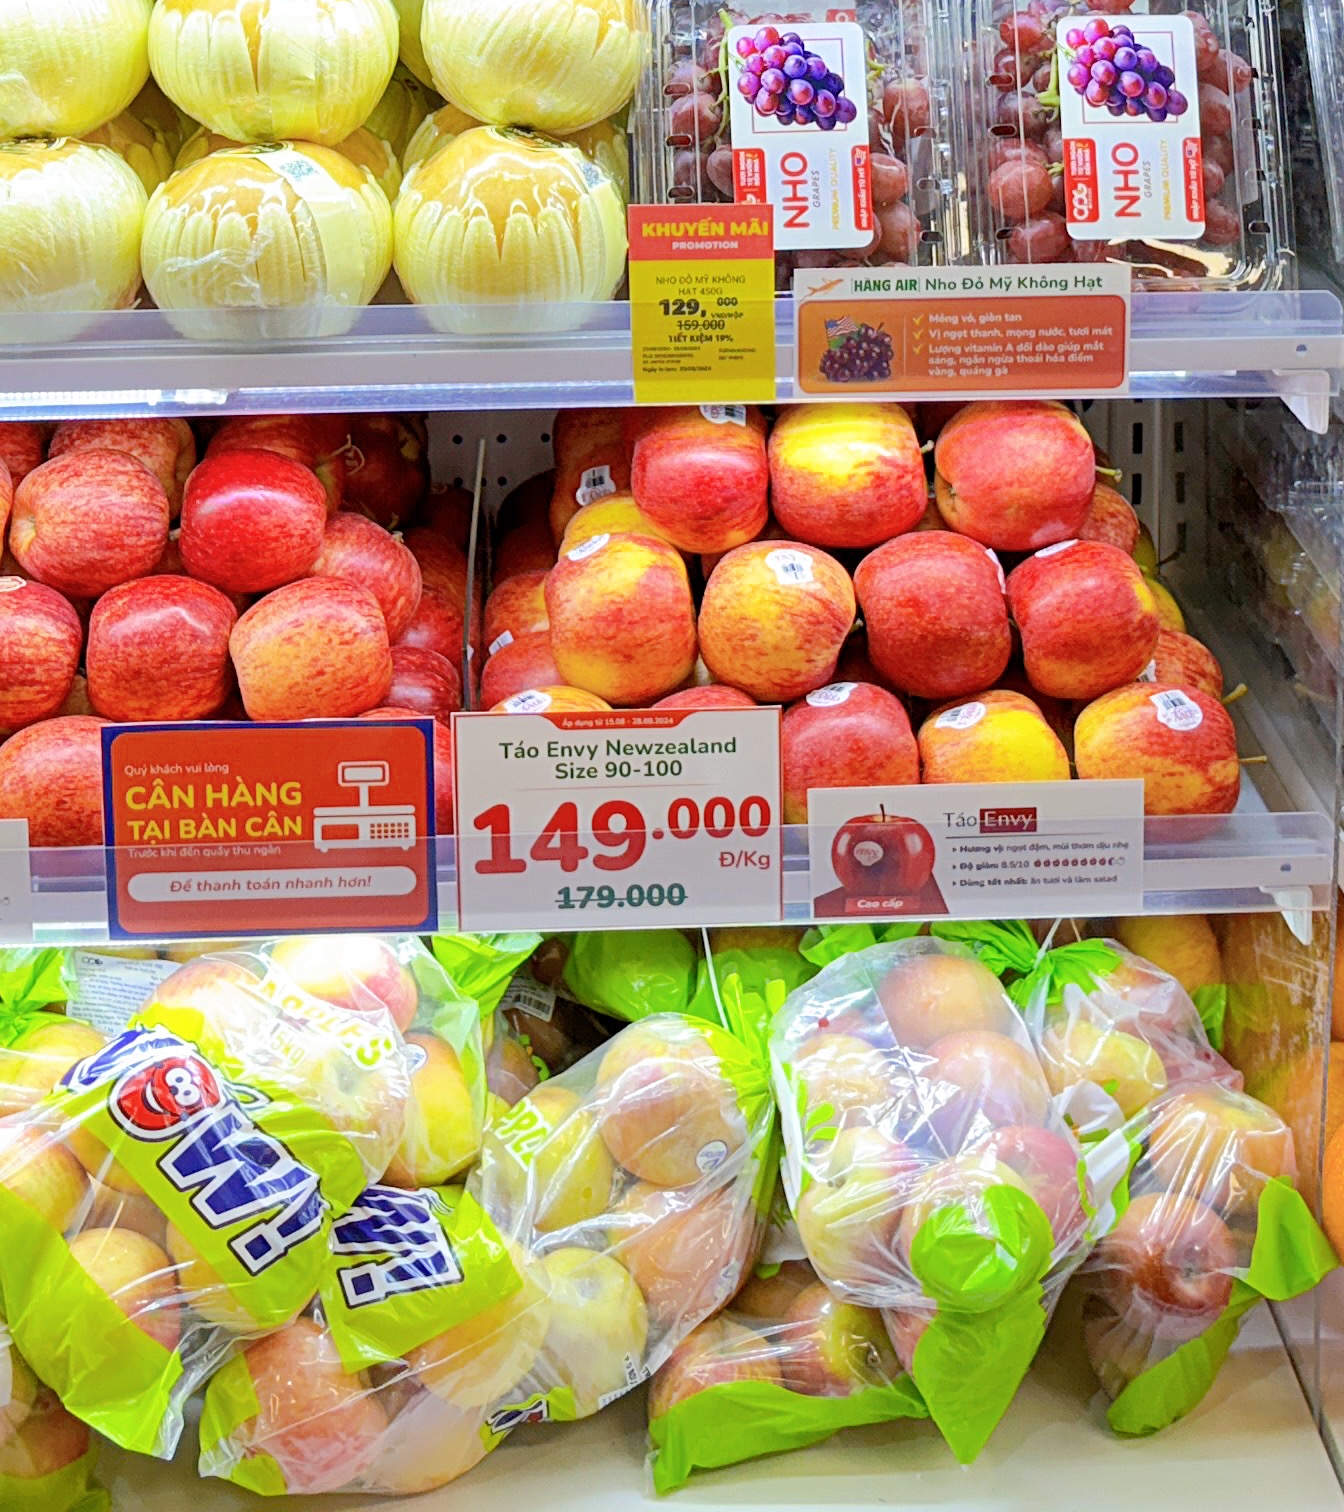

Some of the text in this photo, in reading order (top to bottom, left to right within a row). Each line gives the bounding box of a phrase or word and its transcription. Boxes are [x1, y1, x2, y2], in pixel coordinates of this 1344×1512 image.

[779, 151, 811, 230] NHO
[1110, 141, 1143, 218] NHO
[641, 216, 769, 238] KHUYẾN MÃI
[498, 736, 737, 761] Táo Envy Newzealand
[554, 759, 683, 780] Size 90-100
[942, 810, 1033, 830] Táo Envy
[472, 795, 772, 875] 149.000
[718, 850, 772, 870] Đ/Kg
[554, 882, 689, 909] 179.000
